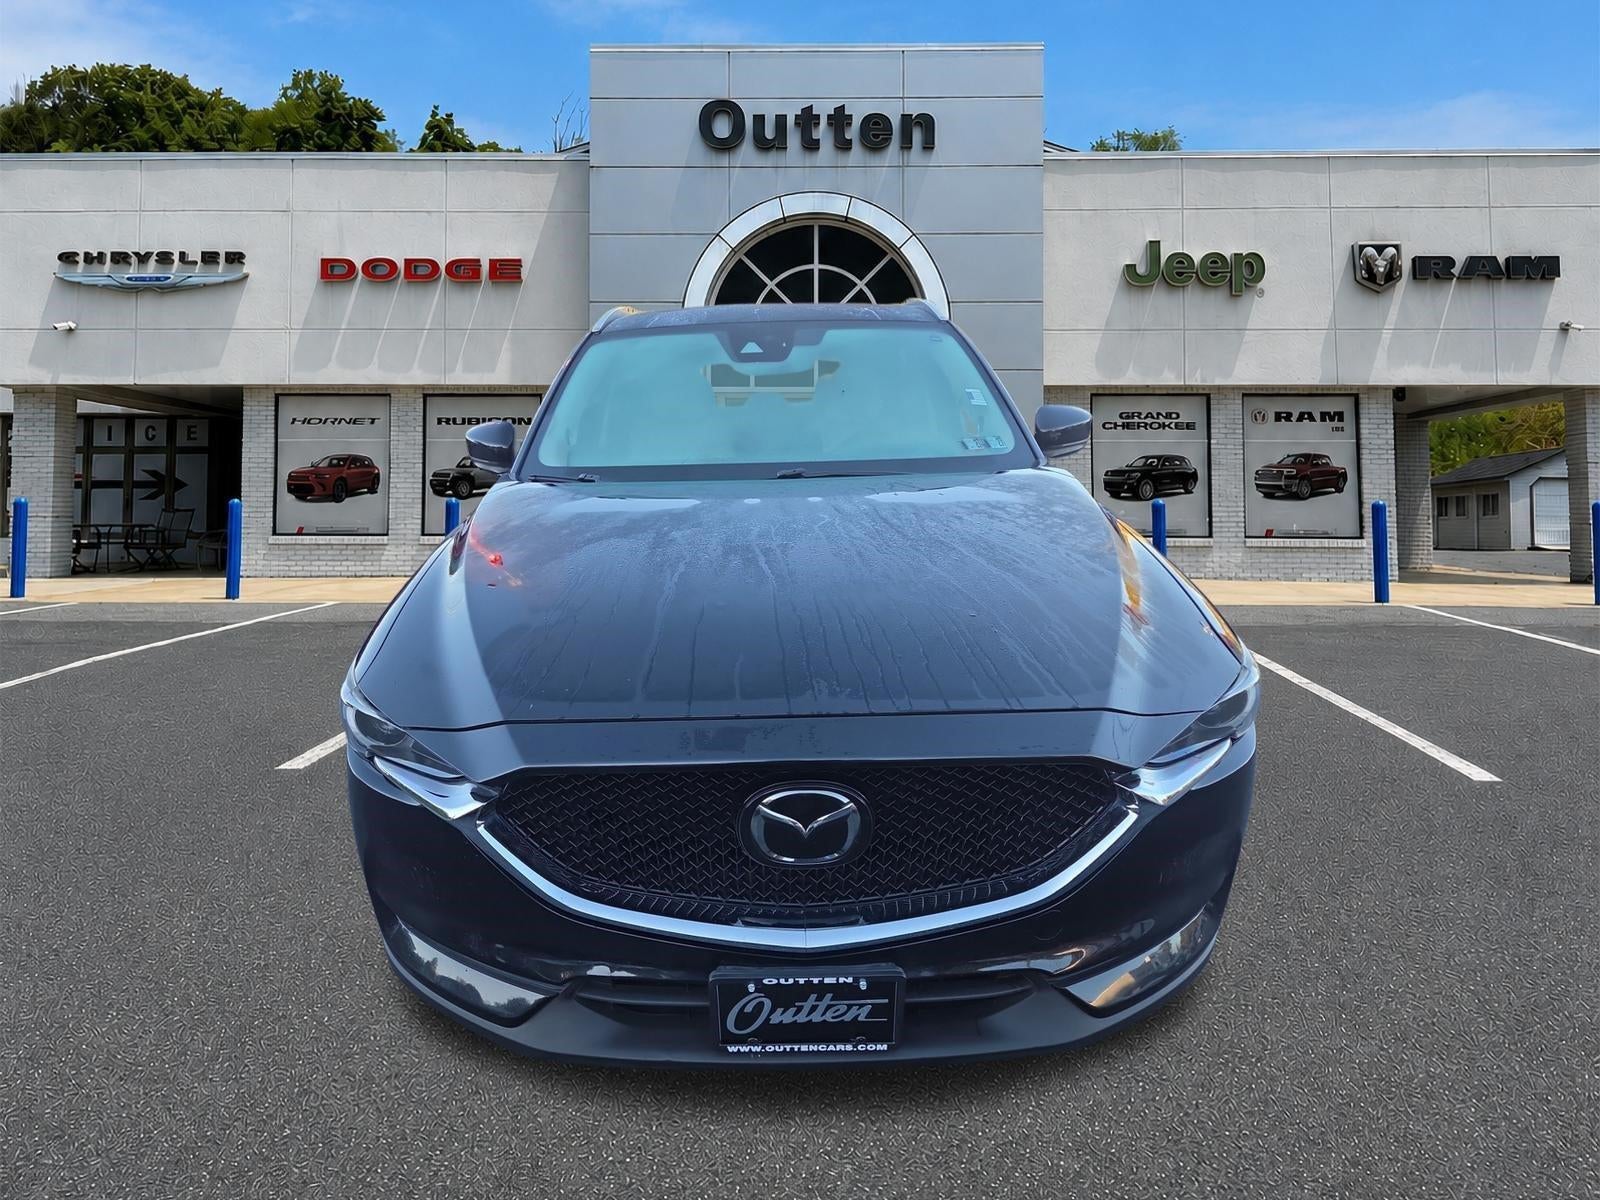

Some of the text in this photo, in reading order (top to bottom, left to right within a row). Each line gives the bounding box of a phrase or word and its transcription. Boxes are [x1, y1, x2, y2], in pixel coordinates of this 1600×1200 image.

[699, 98, 936, 151] Outten
[57, 250, 247, 266] CHRYSLER
[320, 258, 524, 283] DODGE
[1123, 240, 1266, 297] Jeep
[1412, 255, 1561, 280] RAM
[290, 417, 381, 425] HORNET
[1118, 411, 1181, 421] GRAND
[1273, 411, 1345, 423] RAM
[1101, 421, 1197, 431] CHEROKEE
[726, 992, 889, 1035] Outten
[727, 1044, 888, 1053] WWW.OUTTENCARS.COM
